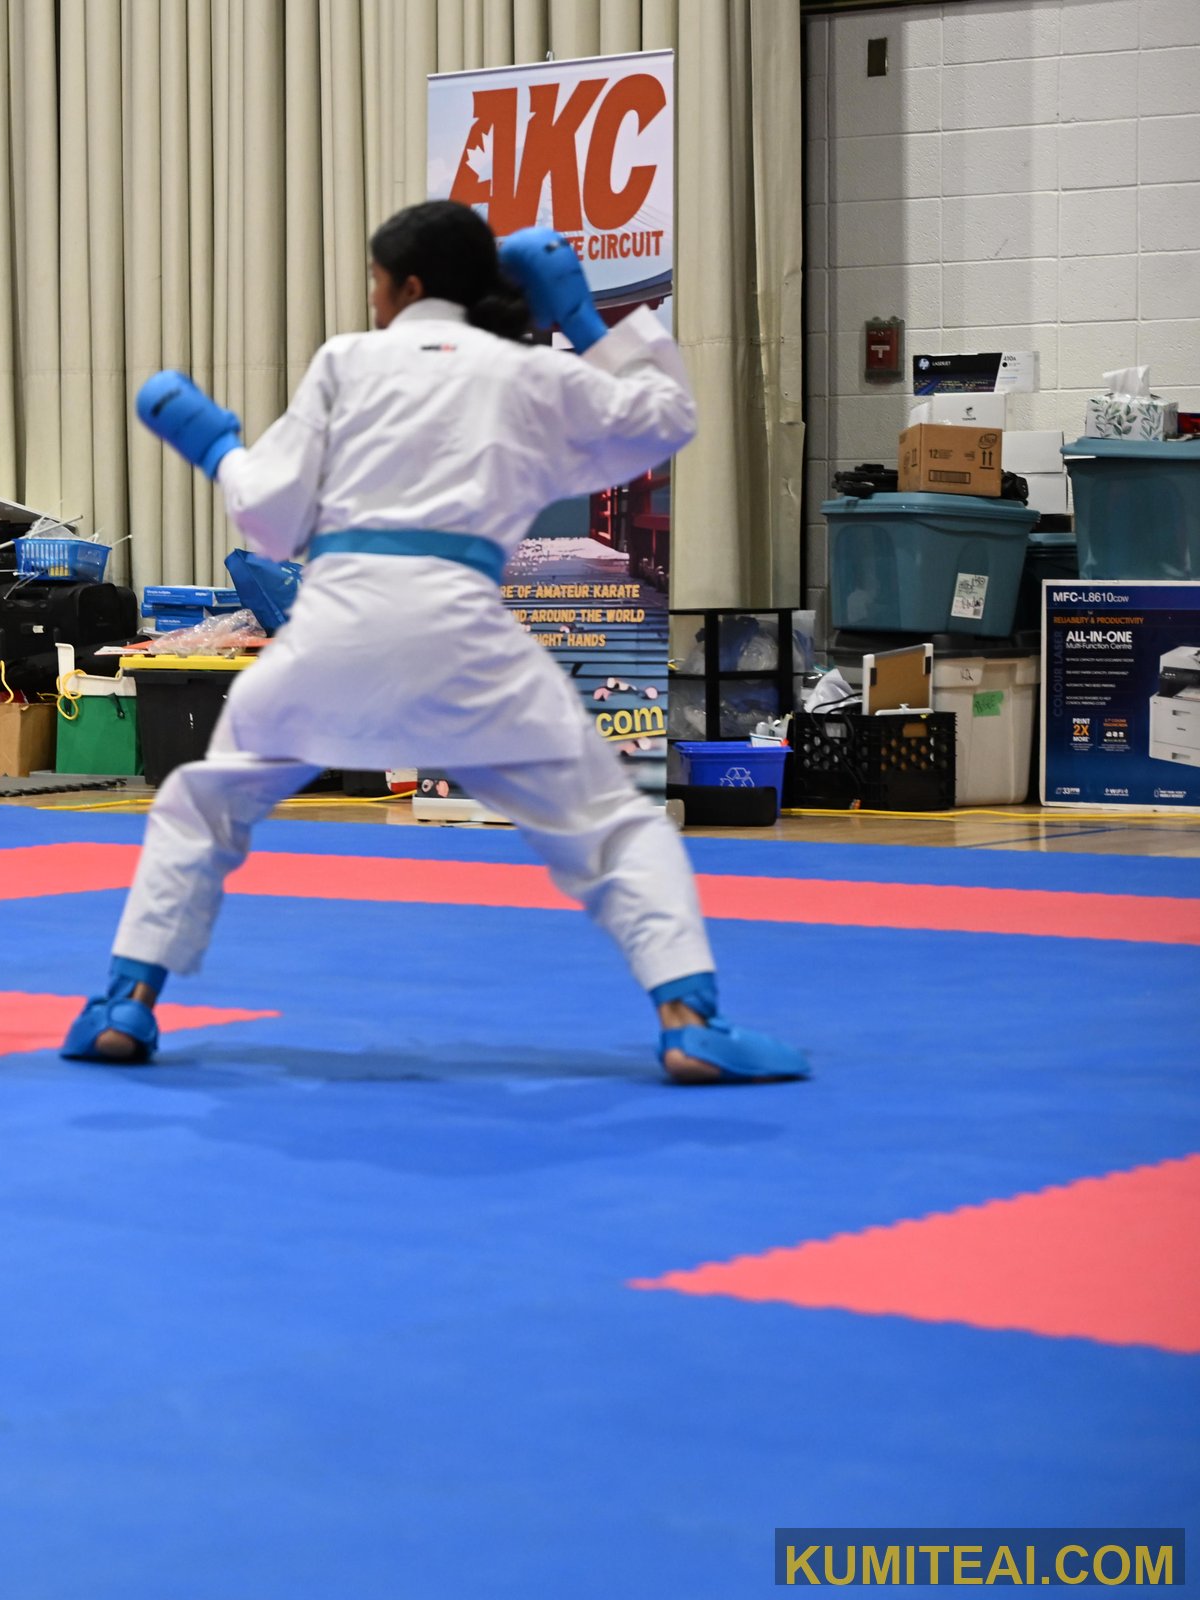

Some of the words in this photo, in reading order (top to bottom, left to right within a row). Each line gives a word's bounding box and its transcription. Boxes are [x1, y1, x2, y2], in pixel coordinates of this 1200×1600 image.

[448, 73, 667, 237] AKC
[588, 230, 664, 261] CIRCUIT
[518, 585, 532, 598] OF
[536, 585, 589, 598] AMATEUR
[594, 585, 640, 598] KARATE
[531, 610, 577, 622] AROUND
[581, 609, 603, 622] THE
[607, 609, 645, 622] WORLD
[1096, 617, 1144, 625] PRODUCTIVITY
[567, 634, 606, 647] HANDS
[1065, 631, 1133, 643] ALL-IN-ONE
[1073, 724, 1089, 736] 2X
